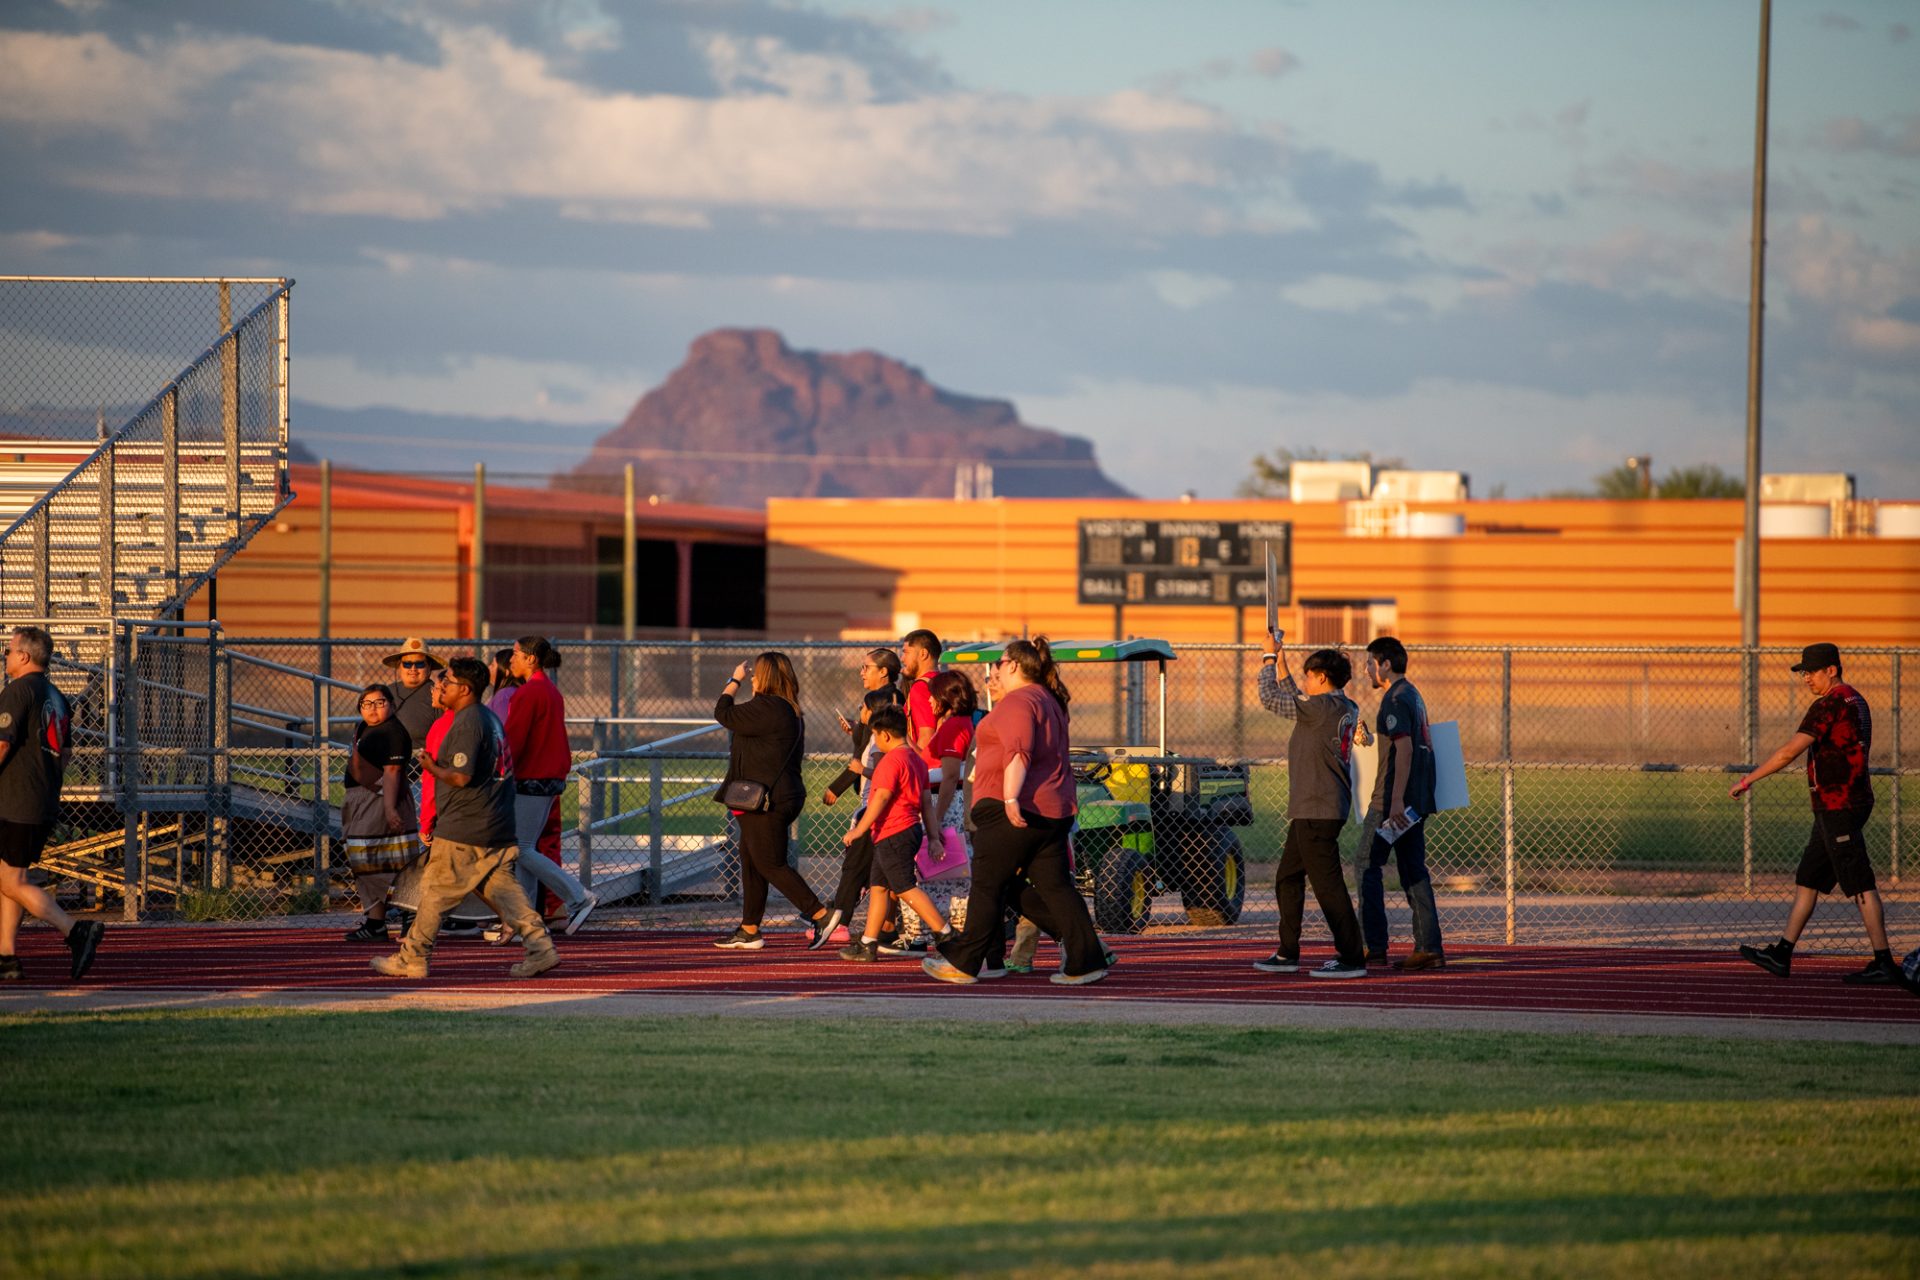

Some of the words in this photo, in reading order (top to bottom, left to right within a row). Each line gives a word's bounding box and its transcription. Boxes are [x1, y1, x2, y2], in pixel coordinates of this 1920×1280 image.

[1085, 521, 1146, 537] VISITOR
[1160, 522, 1220, 538] INNING
[1239, 523, 1286, 538] HOME
[1082, 578, 1125, 596] BALL
[1155, 579, 1211, 597] STRIKE
